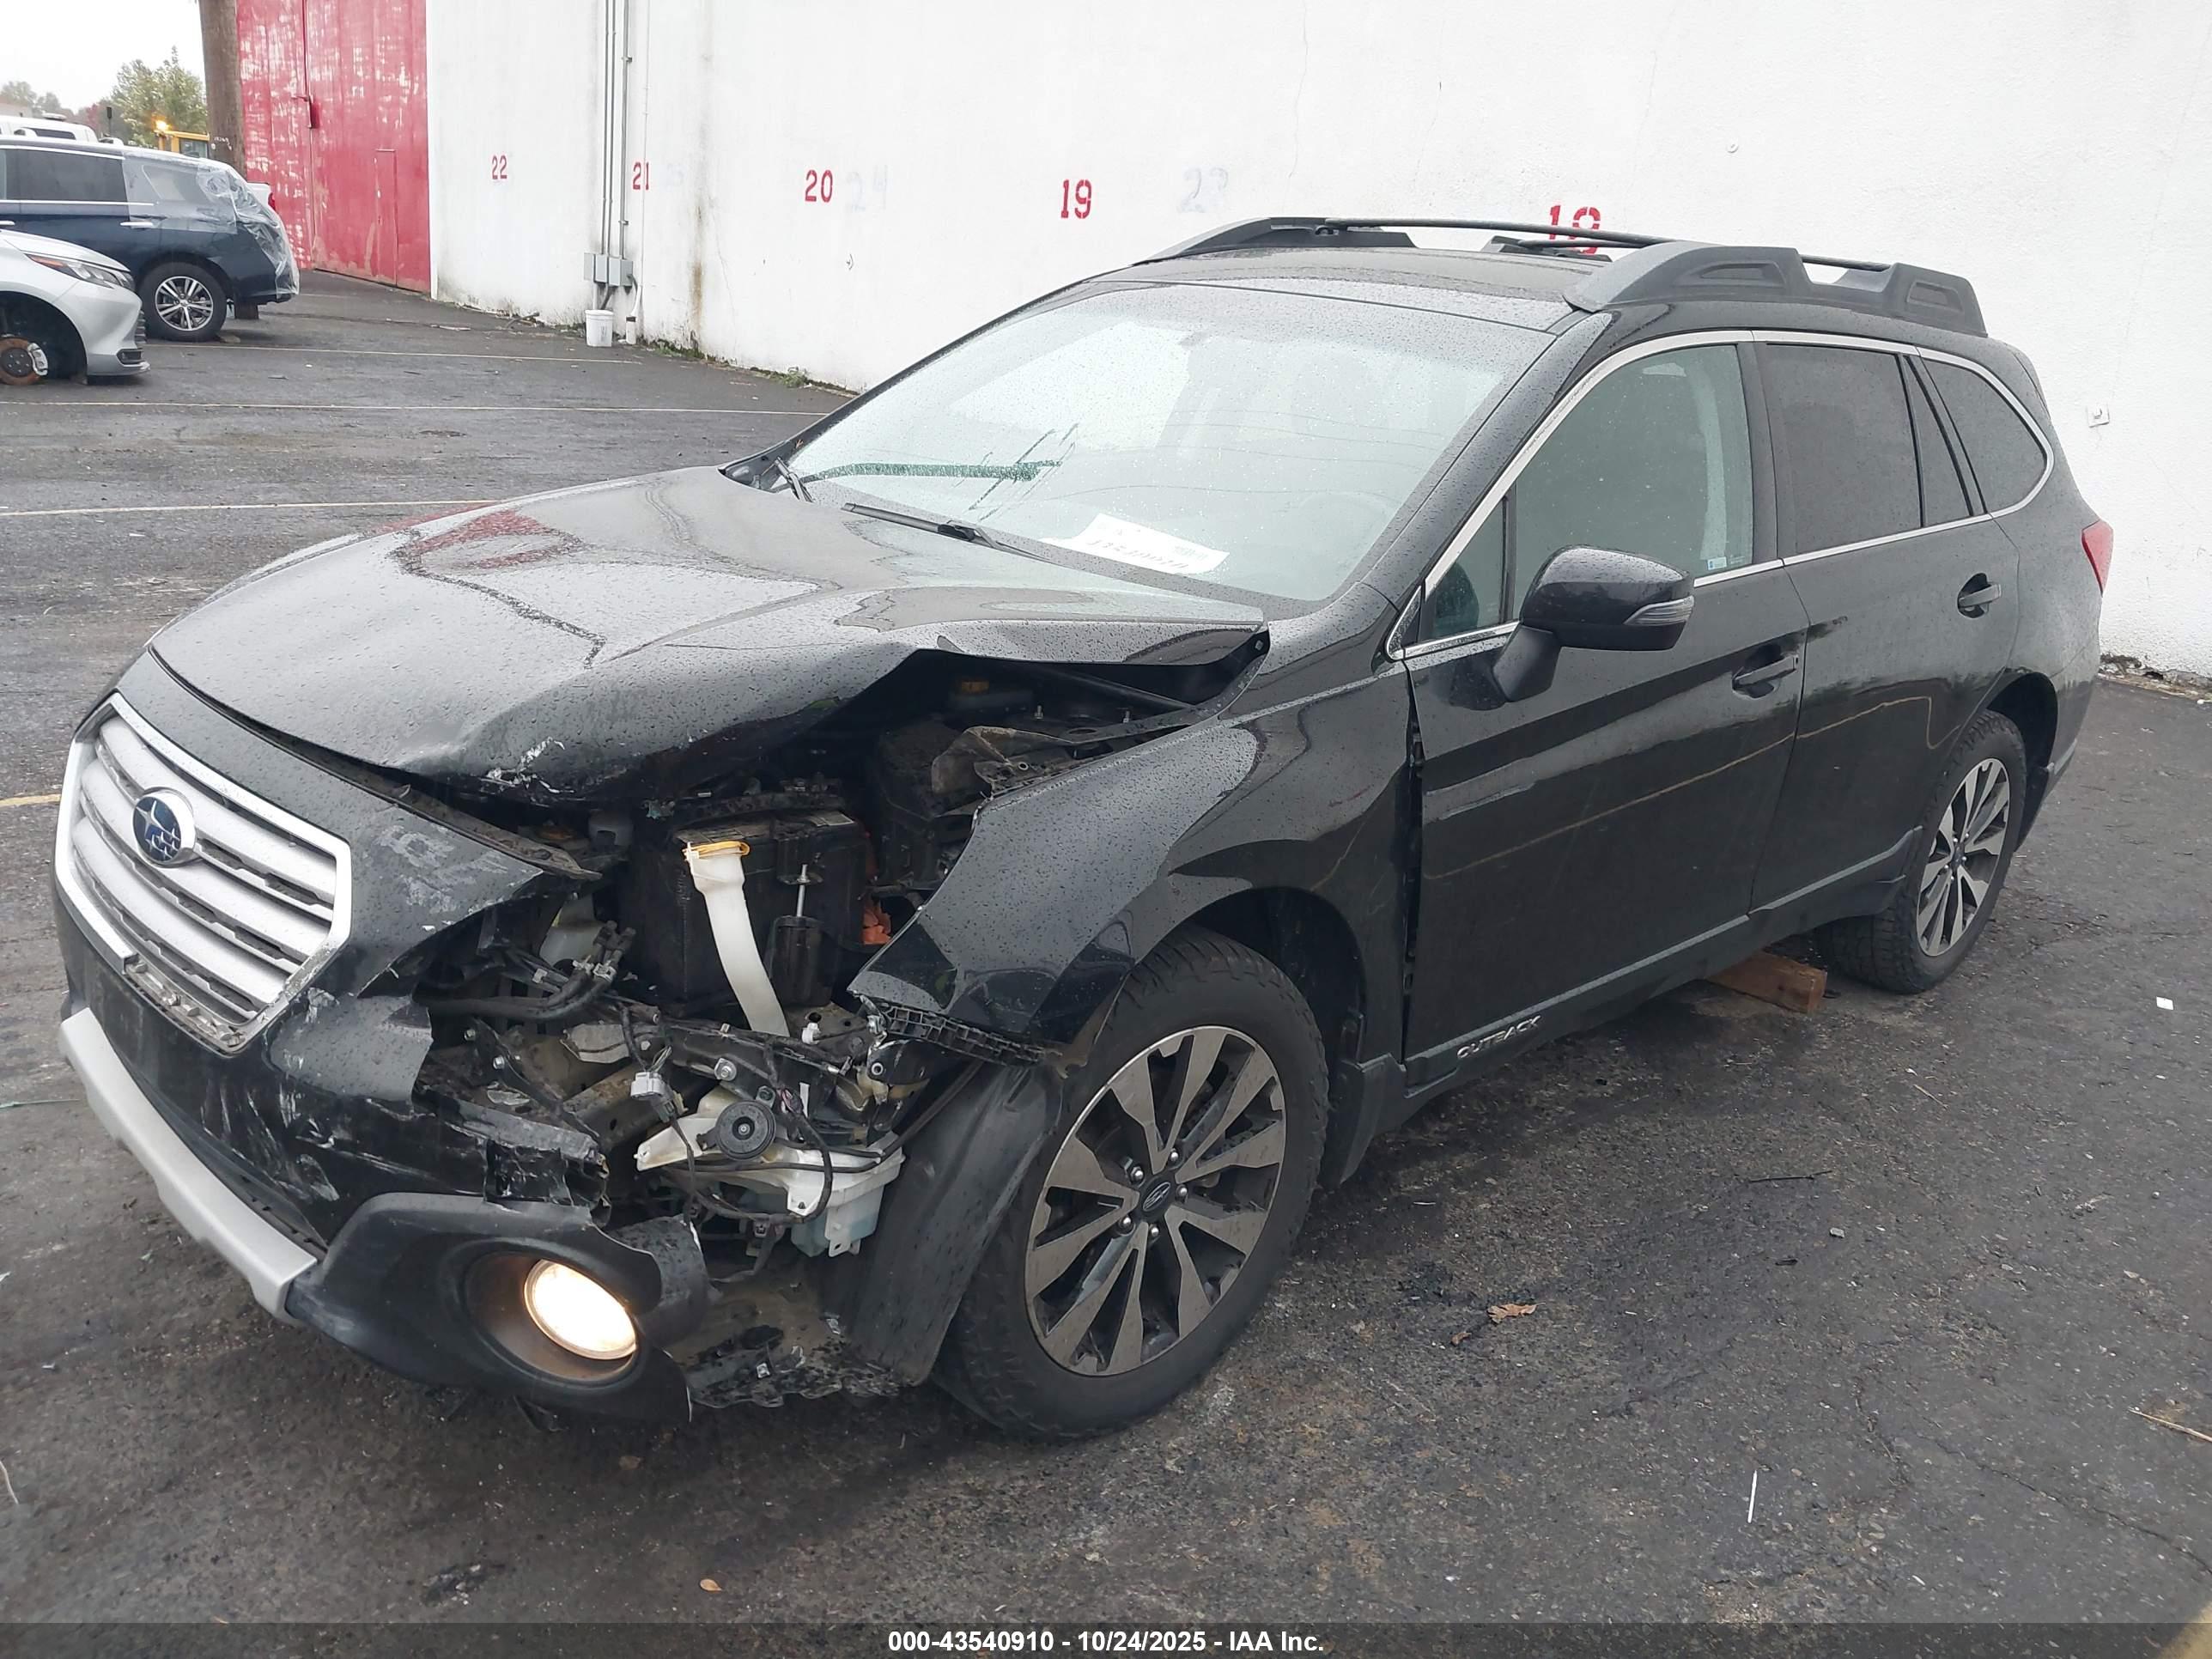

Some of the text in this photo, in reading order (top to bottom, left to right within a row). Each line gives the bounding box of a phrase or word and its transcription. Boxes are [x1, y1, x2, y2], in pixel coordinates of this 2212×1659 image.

[491, 155, 507, 179] 22
[632, 161, 649, 191] 21
[805, 169, 833, 204] 20
[1060, 179, 1092, 219] 19
